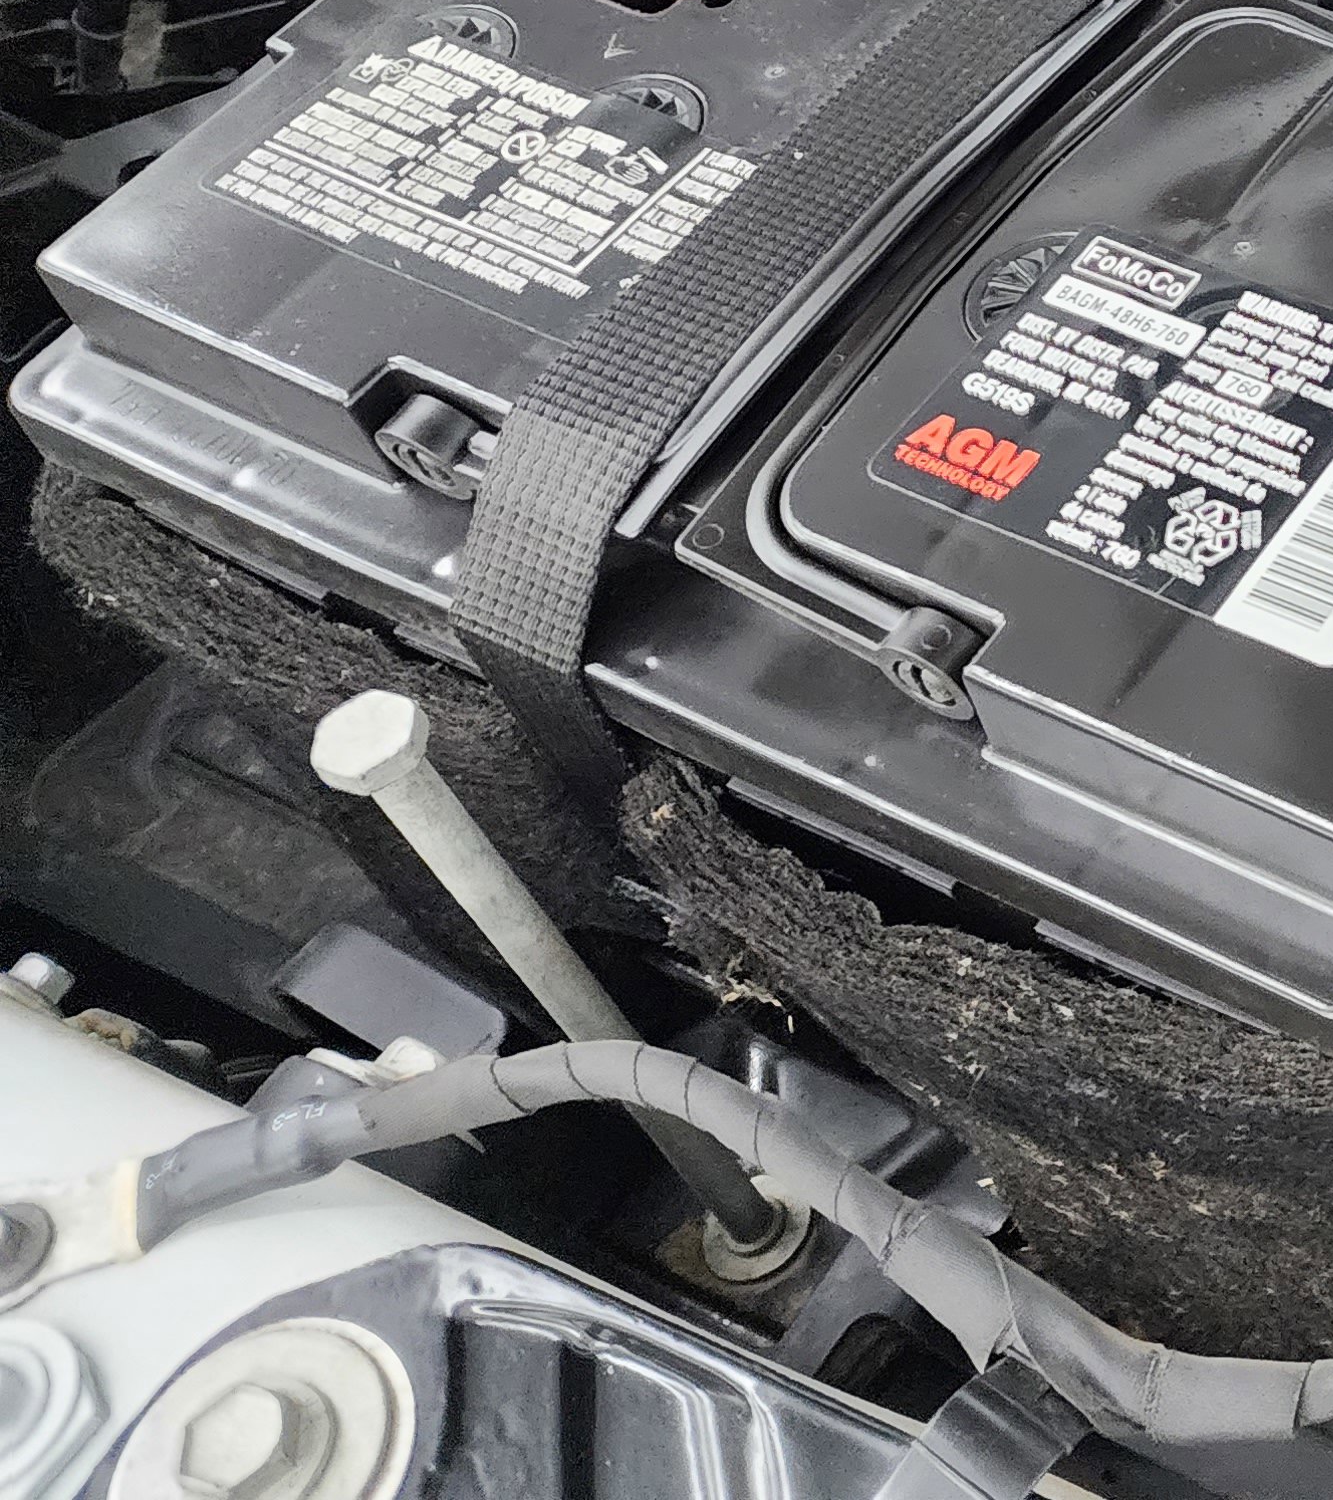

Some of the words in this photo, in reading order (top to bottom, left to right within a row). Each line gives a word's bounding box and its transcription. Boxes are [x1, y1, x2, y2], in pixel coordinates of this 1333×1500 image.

[428, 42, 592, 120] DANGER/POISON
[1081, 245, 1187, 300] FoMoCo
[1053, 284, 1193, 347] BAGM-48H6-760
[1236, 290, 1323, 338] WARNING:
[999, 330, 1046, 361] FORD
[1038, 345, 1098, 382] MOTOR
[1119, 354, 1160, 380] PAR
[1223, 375, 1264, 399] 760
[1158, 380, 1308, 449] AVERTISSEMENT
[894, 444, 1011, 501] TECHNOLOGY
[904, 414, 1041, 489] AGM
[1100, 539, 1141, 570] 760
[273, 1100, 324, 1131] FL-3
